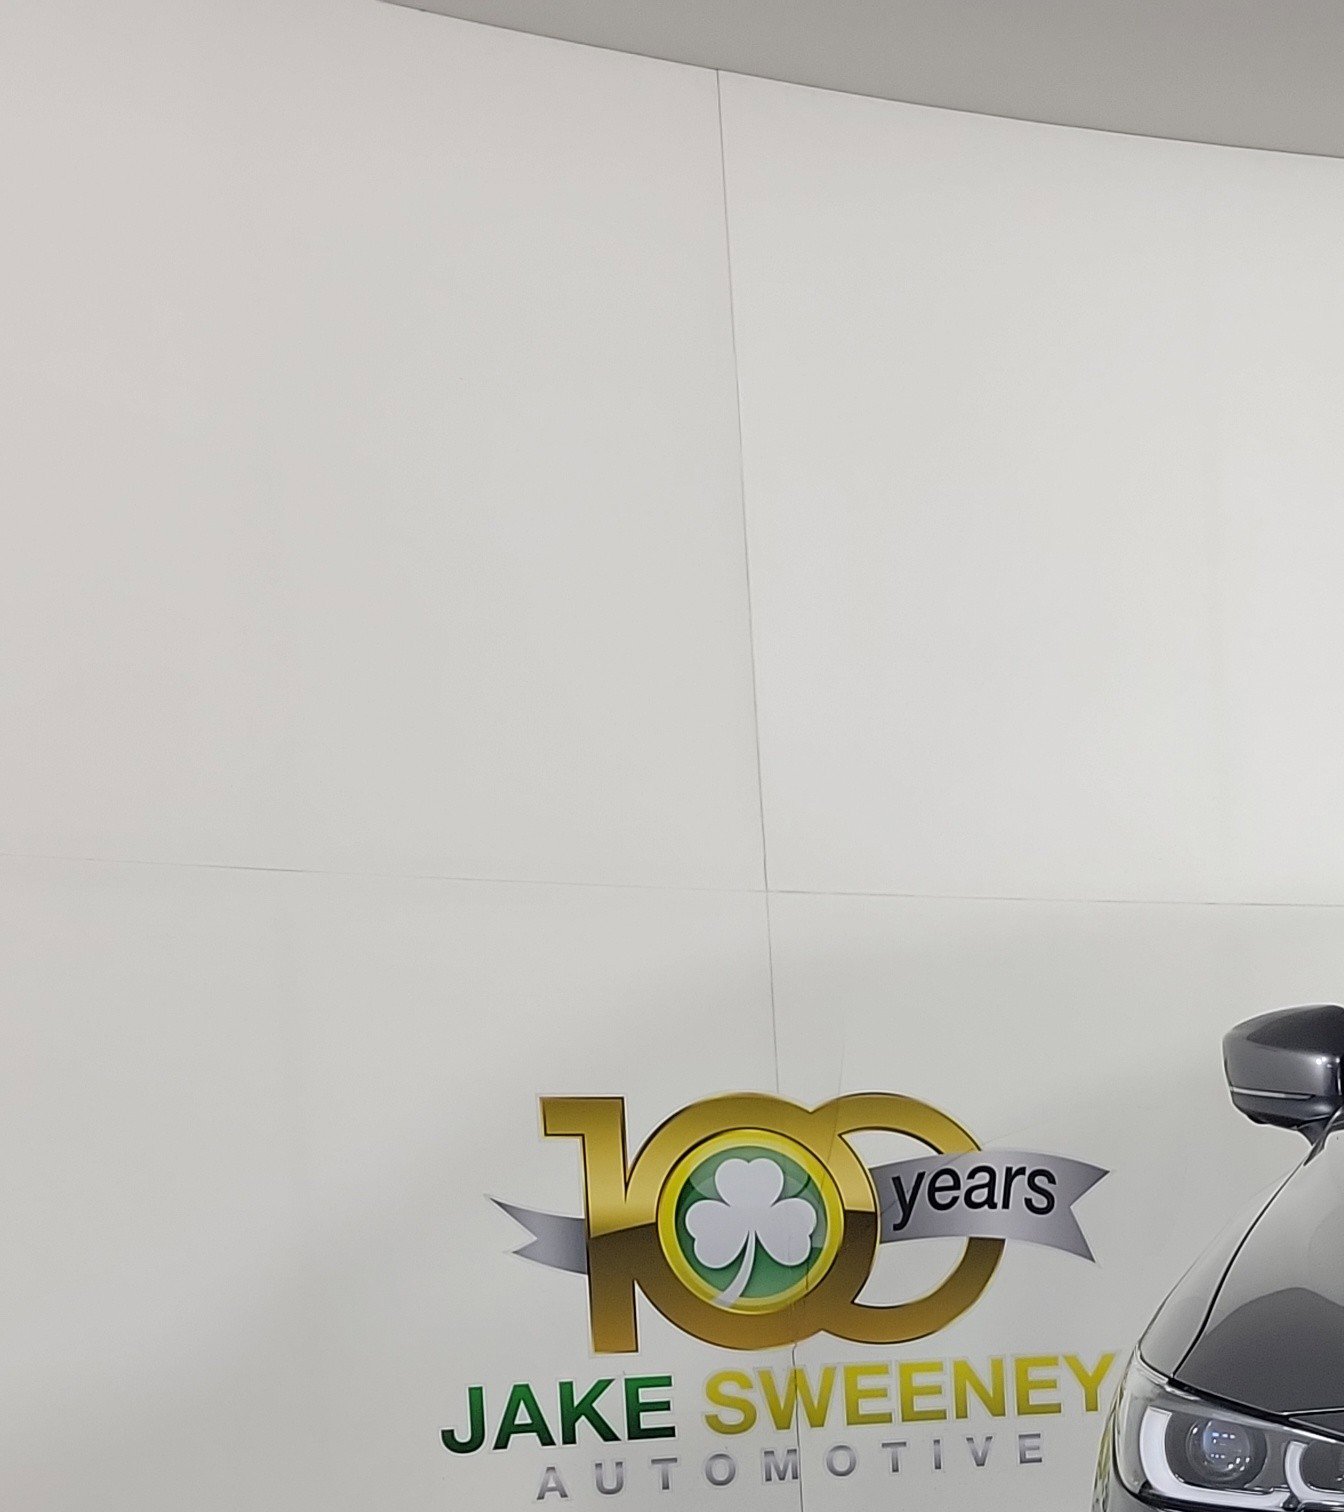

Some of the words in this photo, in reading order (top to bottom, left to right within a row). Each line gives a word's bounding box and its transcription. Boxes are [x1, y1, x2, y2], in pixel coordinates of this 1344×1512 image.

[538, 1092, 1006, 1353] 100
[890, 1162, 1058, 1231] years
[441, 1375, 676, 1454] JAKE
[704, 1353, 1117, 1436] SWEENEY
[536, 1433, 1044, 1501] AUTOMOTIVE
